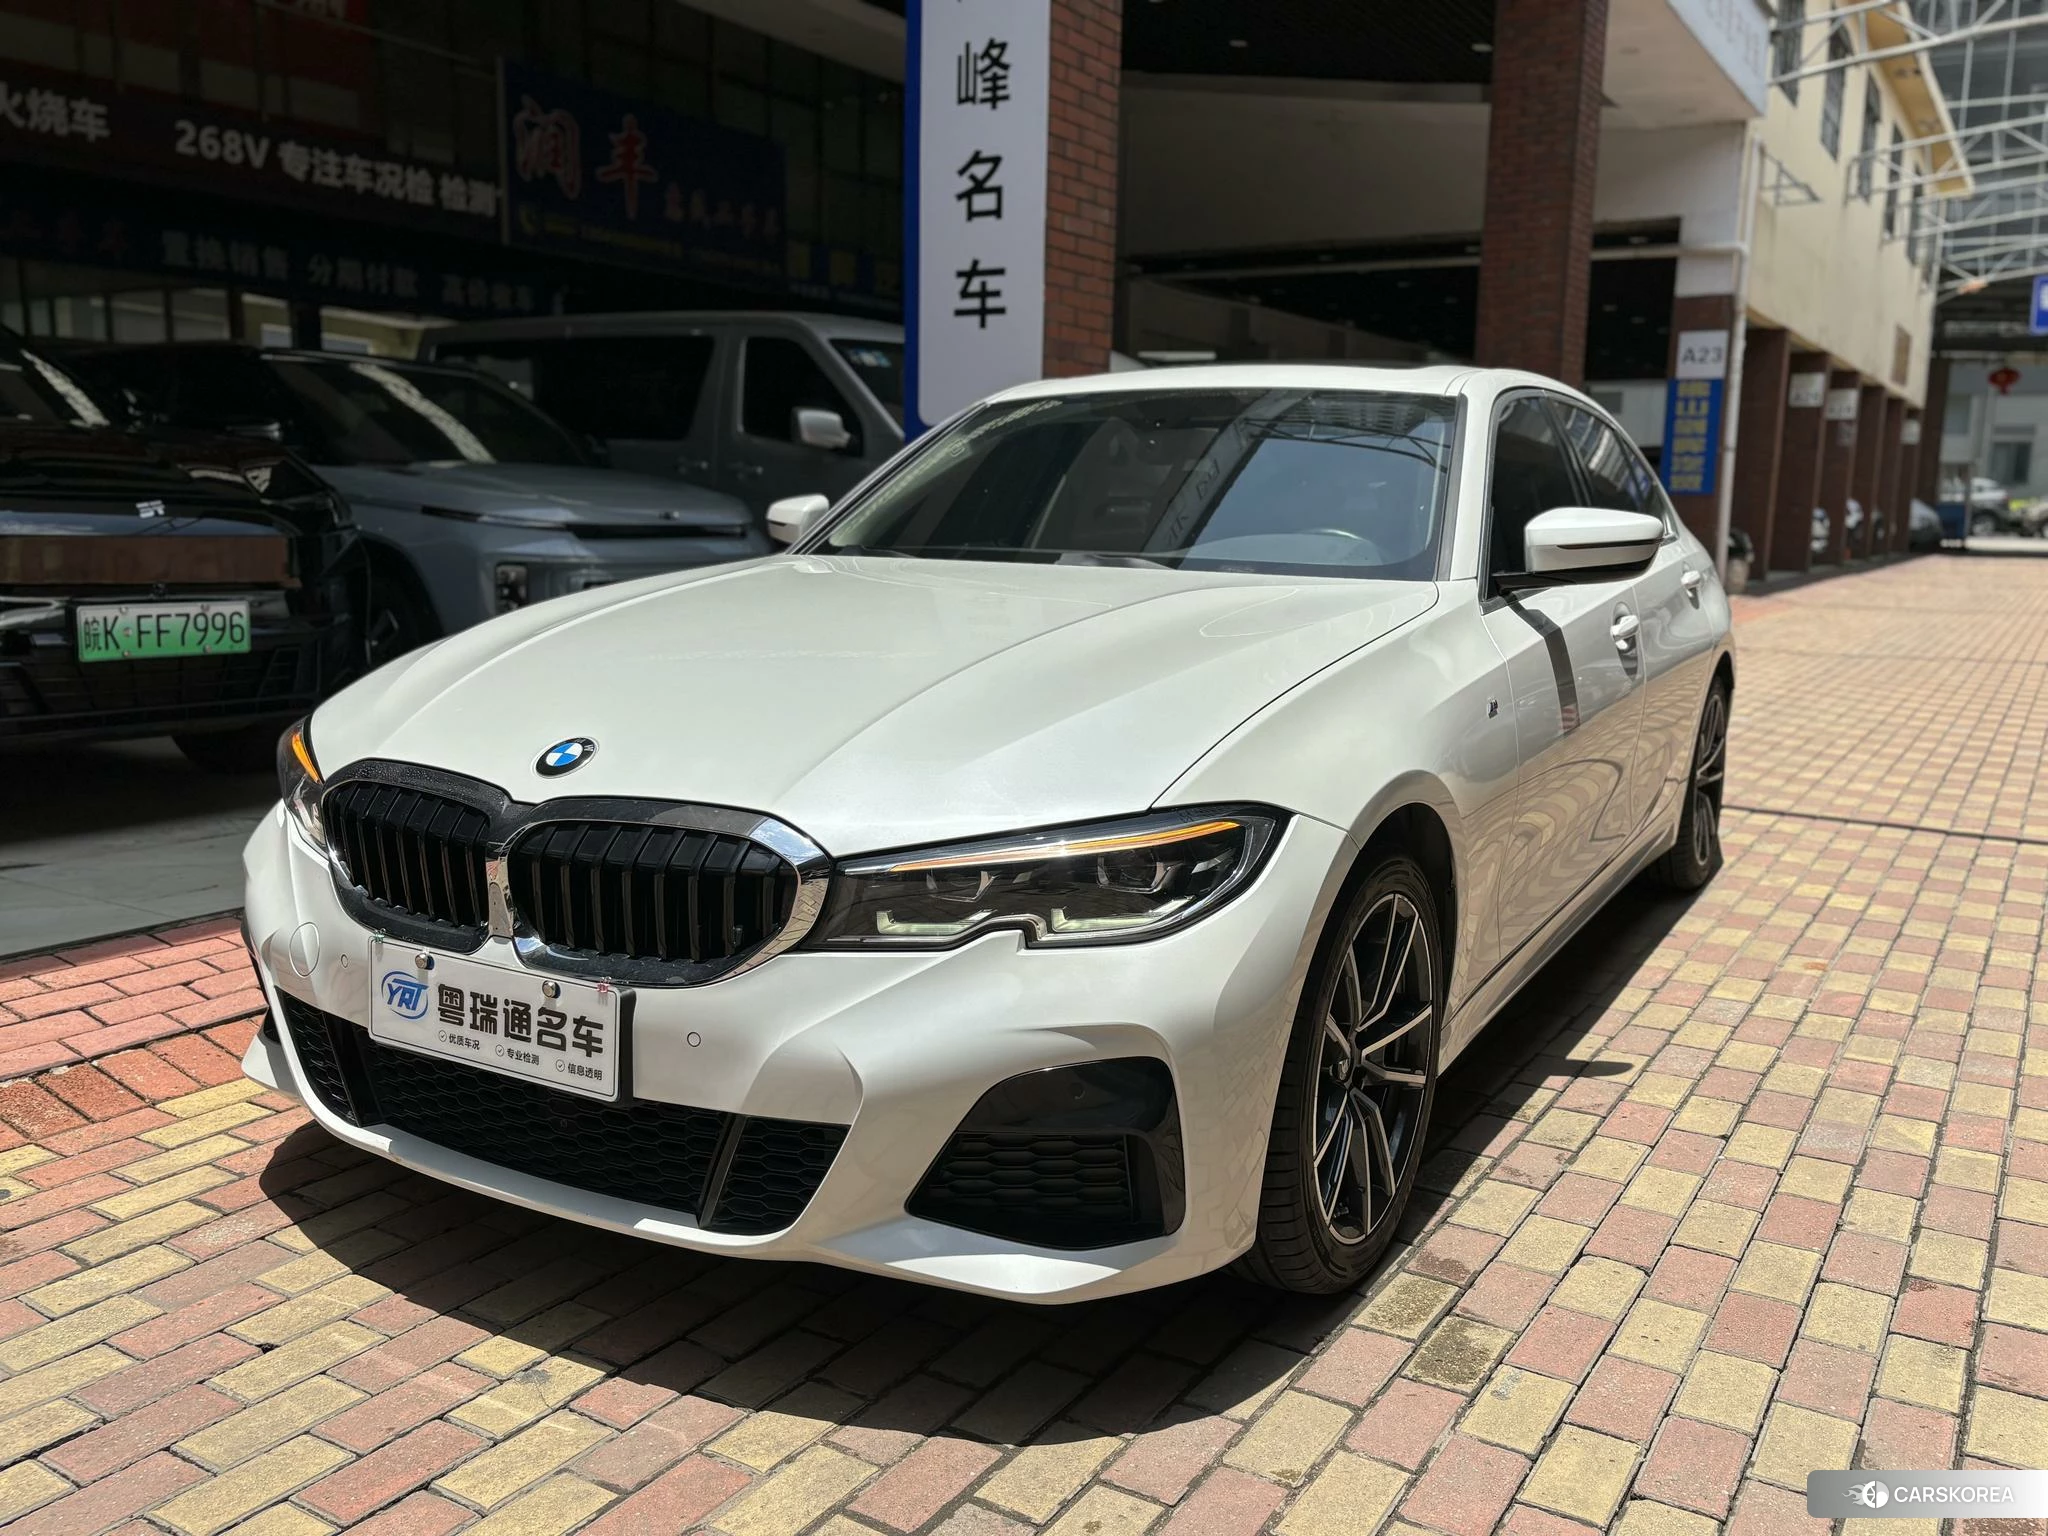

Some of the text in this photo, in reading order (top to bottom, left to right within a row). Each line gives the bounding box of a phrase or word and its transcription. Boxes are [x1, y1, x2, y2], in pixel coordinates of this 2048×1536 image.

[174, 120, 503, 218] 268V 专注车况检 检测
[953, 0, 1012, 330] 峰名车
[1681, 346, 1724, 364] A23
[136, 611, 246, 649] FF7996
[386, 977, 429, 1011] YRT
[437, 982, 605, 1058] 粤瑞通名车
[448, 1033, 604, 1081] 优质车况 专业检测 信息透明
